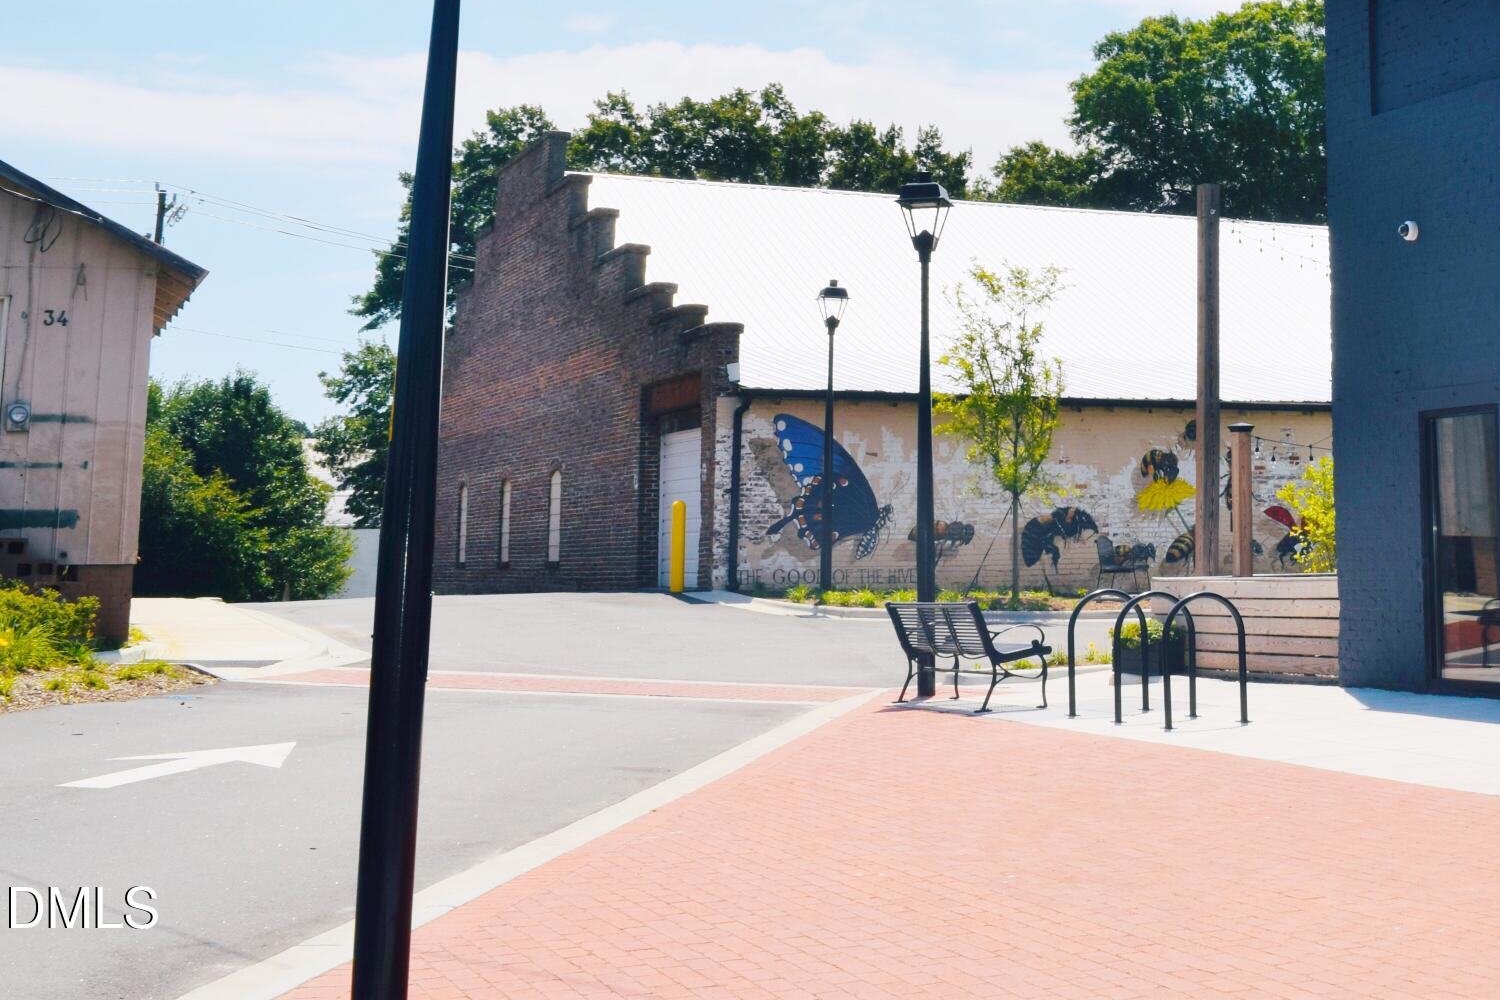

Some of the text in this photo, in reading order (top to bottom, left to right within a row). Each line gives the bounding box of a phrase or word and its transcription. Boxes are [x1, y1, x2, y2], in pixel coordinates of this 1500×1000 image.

[43, 309, 68, 326] 34
[736, 568, 763, 585] THE
[832, 568, 854, 584] OF
[856, 568, 885, 584] THE
